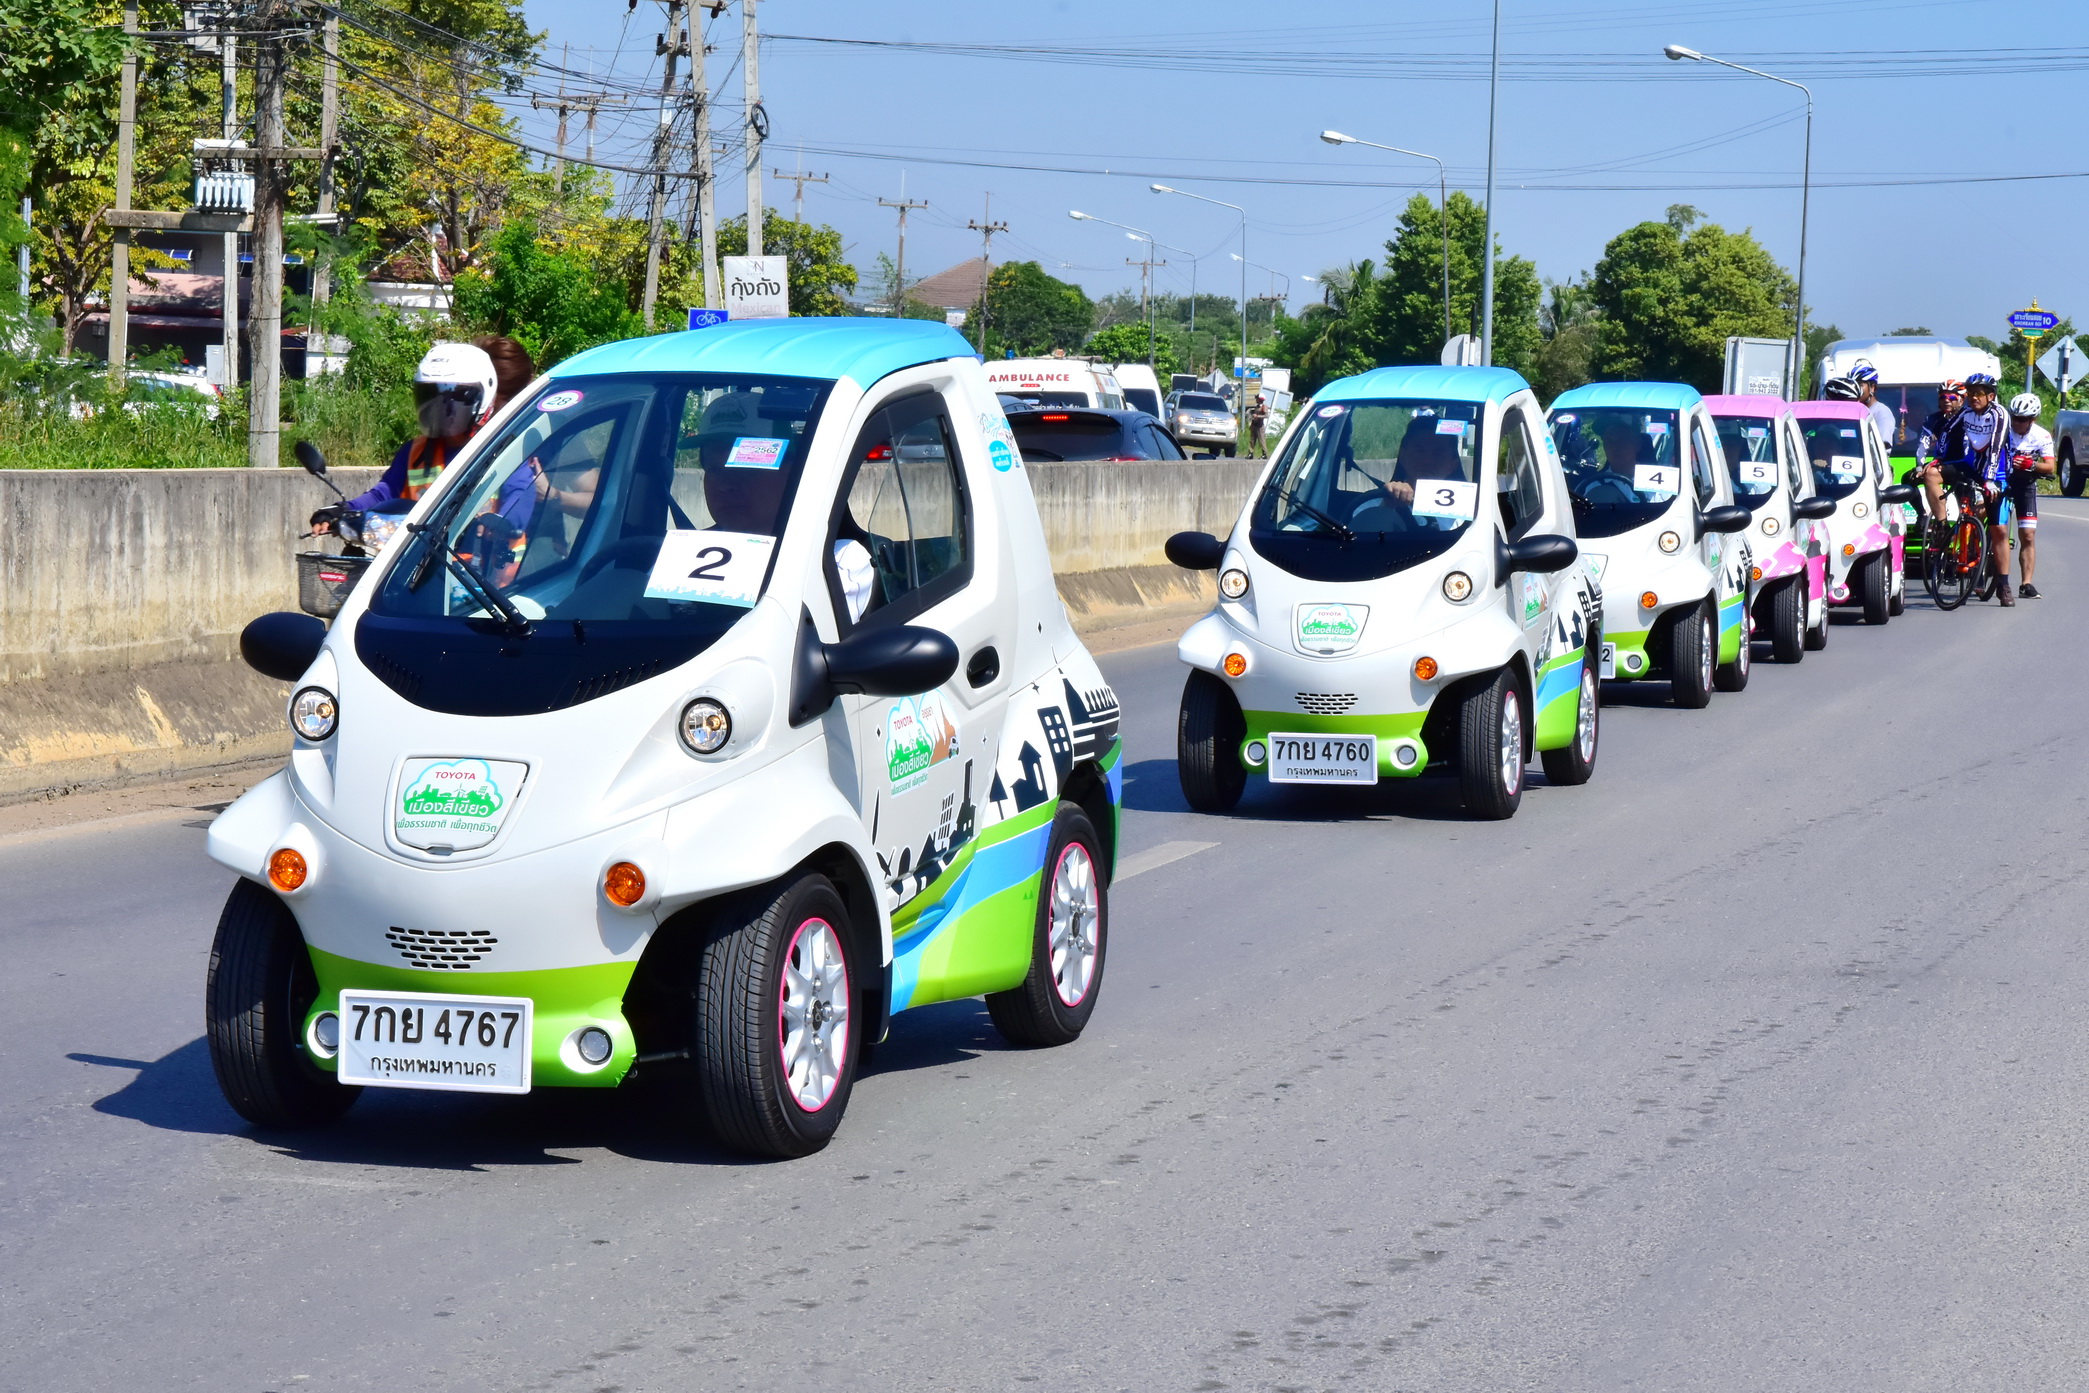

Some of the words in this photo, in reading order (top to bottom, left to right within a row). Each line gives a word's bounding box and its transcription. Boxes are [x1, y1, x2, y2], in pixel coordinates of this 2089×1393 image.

[731, 276, 781, 301] กุ้งถัง
[2042, 316, 2052, 325] 10
[988, 373, 1070, 382] AMBULANCE
[547, 396, 572, 406] 28
[754, 446, 778, 454] 2562
[1842, 460, 1853, 470] 6
[1649, 472, 1664, 485] 4
[1752, 467, 1765, 478] 5
[1434, 489, 1455, 507] 3
[687, 546, 733, 581] 2
[893, 715, 914, 731] TOYOTA
[1275, 740, 1316, 761] 7กย
[1321, 742, 1370, 762] 4760
[435, 771, 476, 781] TOYOTA
[1286, 767, 1358, 779] กรุงเทพมหานคร
[408, 798, 489, 816] เมืองสีเขียว
[352, 1004, 424, 1044] 7กย
[434, 1009, 520, 1049] 4767
[370, 1056, 497, 1078] กรุงเทพมหานคร
